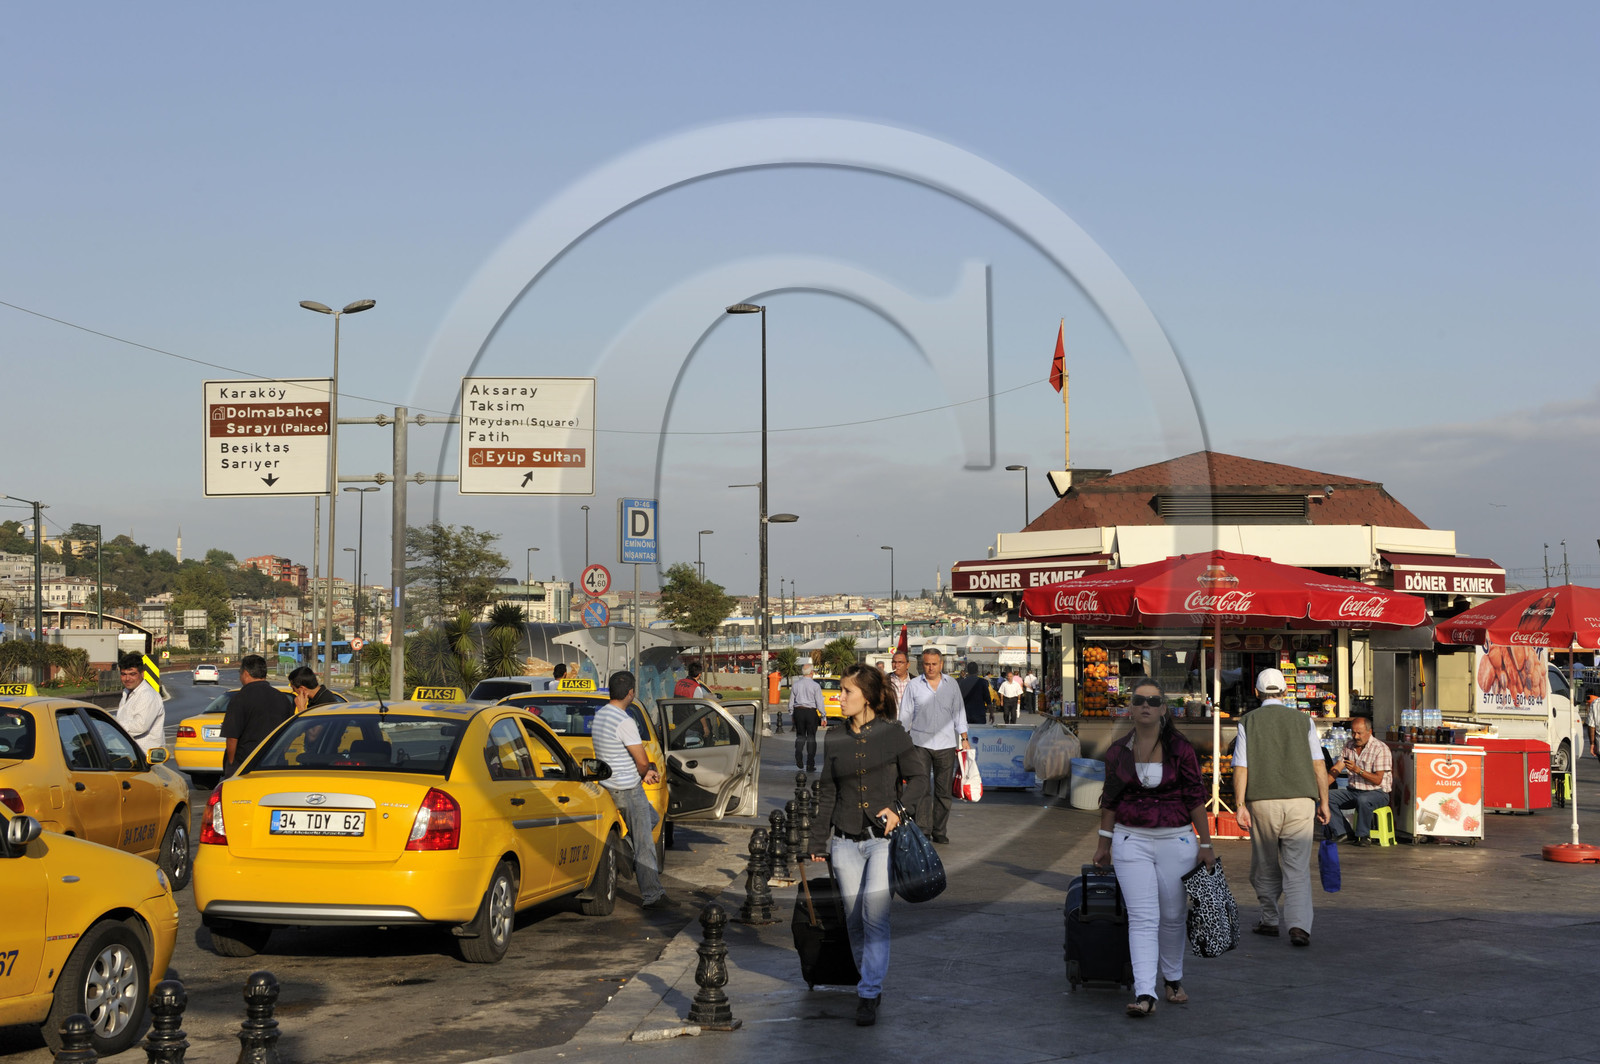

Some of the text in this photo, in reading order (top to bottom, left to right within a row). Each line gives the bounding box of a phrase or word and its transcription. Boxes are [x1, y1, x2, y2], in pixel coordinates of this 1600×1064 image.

[220, 387, 286, 400] Karaköy
[470, 384, 538, 398] Aksaray
[226, 406, 323, 420] Dolmabahçe
[470, 401, 525, 412] Taksim
[226, 422, 328, 436] Sarayı (Palace)
[468, 431, 510, 442] Fatih
[220, 442, 290, 454] Beşiktaş
[221, 458, 280, 471] Sarıyer
[486, 450, 582, 465] Eyüp Sultan
[631, 509, 650, 537] D
[624, 539, 656, 549] EMİNÖNÜ
[624, 551, 656, 561] NİŞANTAŞI
[969, 571, 1022, 590] DÖNER
[1405, 572, 1494, 593] DÖNER EKMEK
[1054, 590, 1099, 612] Coca-Cola
[1184, 590, 1257, 612] Coca-Cola
[1338, 595, 1390, 618] Coca-Cola
[1510, 631, 1551, 645] Coca-Cola
[1483, 693, 1494, 704] 577
[280, 813, 296, 829] 34
[307, 814, 332, 830] TDY
[343, 815, 361, 830] 62
